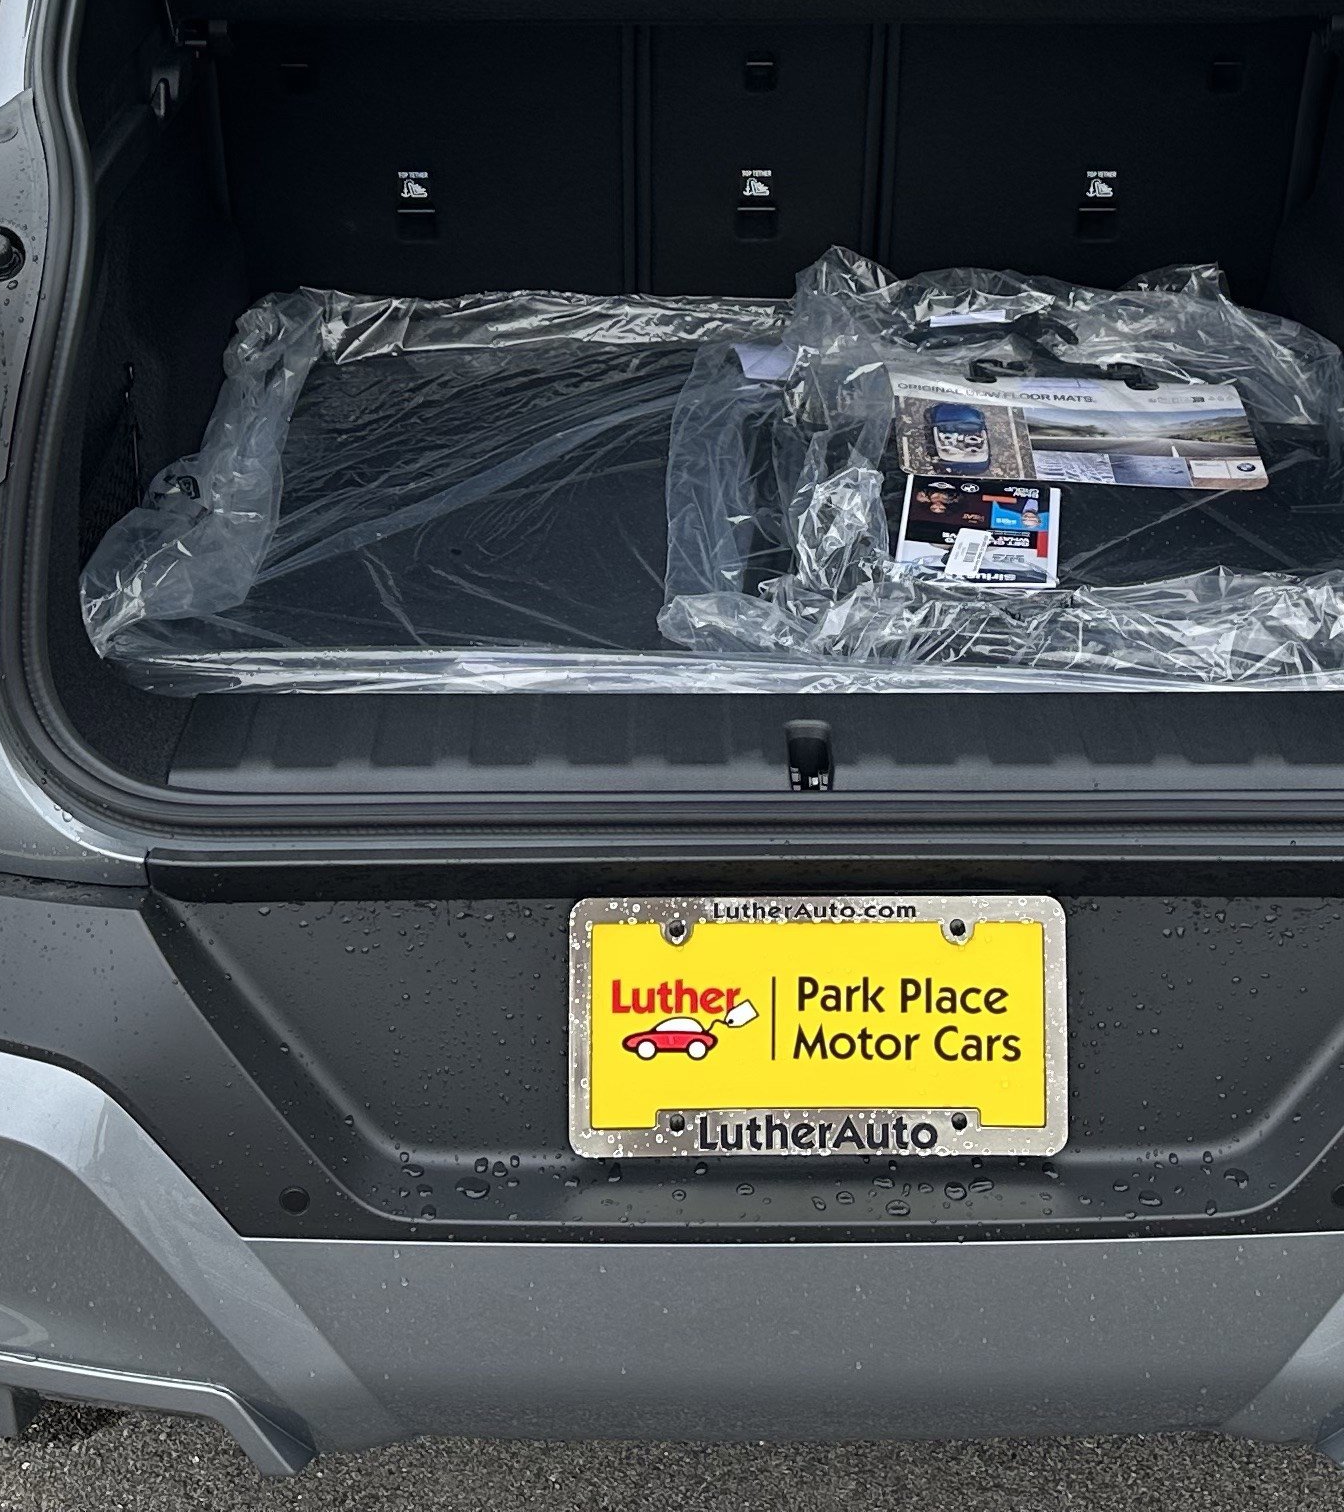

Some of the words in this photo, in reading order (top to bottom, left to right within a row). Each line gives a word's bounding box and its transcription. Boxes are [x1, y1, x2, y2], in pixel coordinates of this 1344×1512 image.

[897, 382, 960, 395] ORIGINAL
[1002, 390, 1050, 401] FLOOR
[713, 901, 917, 920] LutherAuto.com
[611, 979, 741, 1014] Luther
[797, 977, 886, 1013] Park
[900, 978, 1009, 1014] Place
[792, 1024, 920, 1061] Motor
[934, 1027, 1022, 1062] Cars
[698, 1116, 938, 1152] LutherAuto
